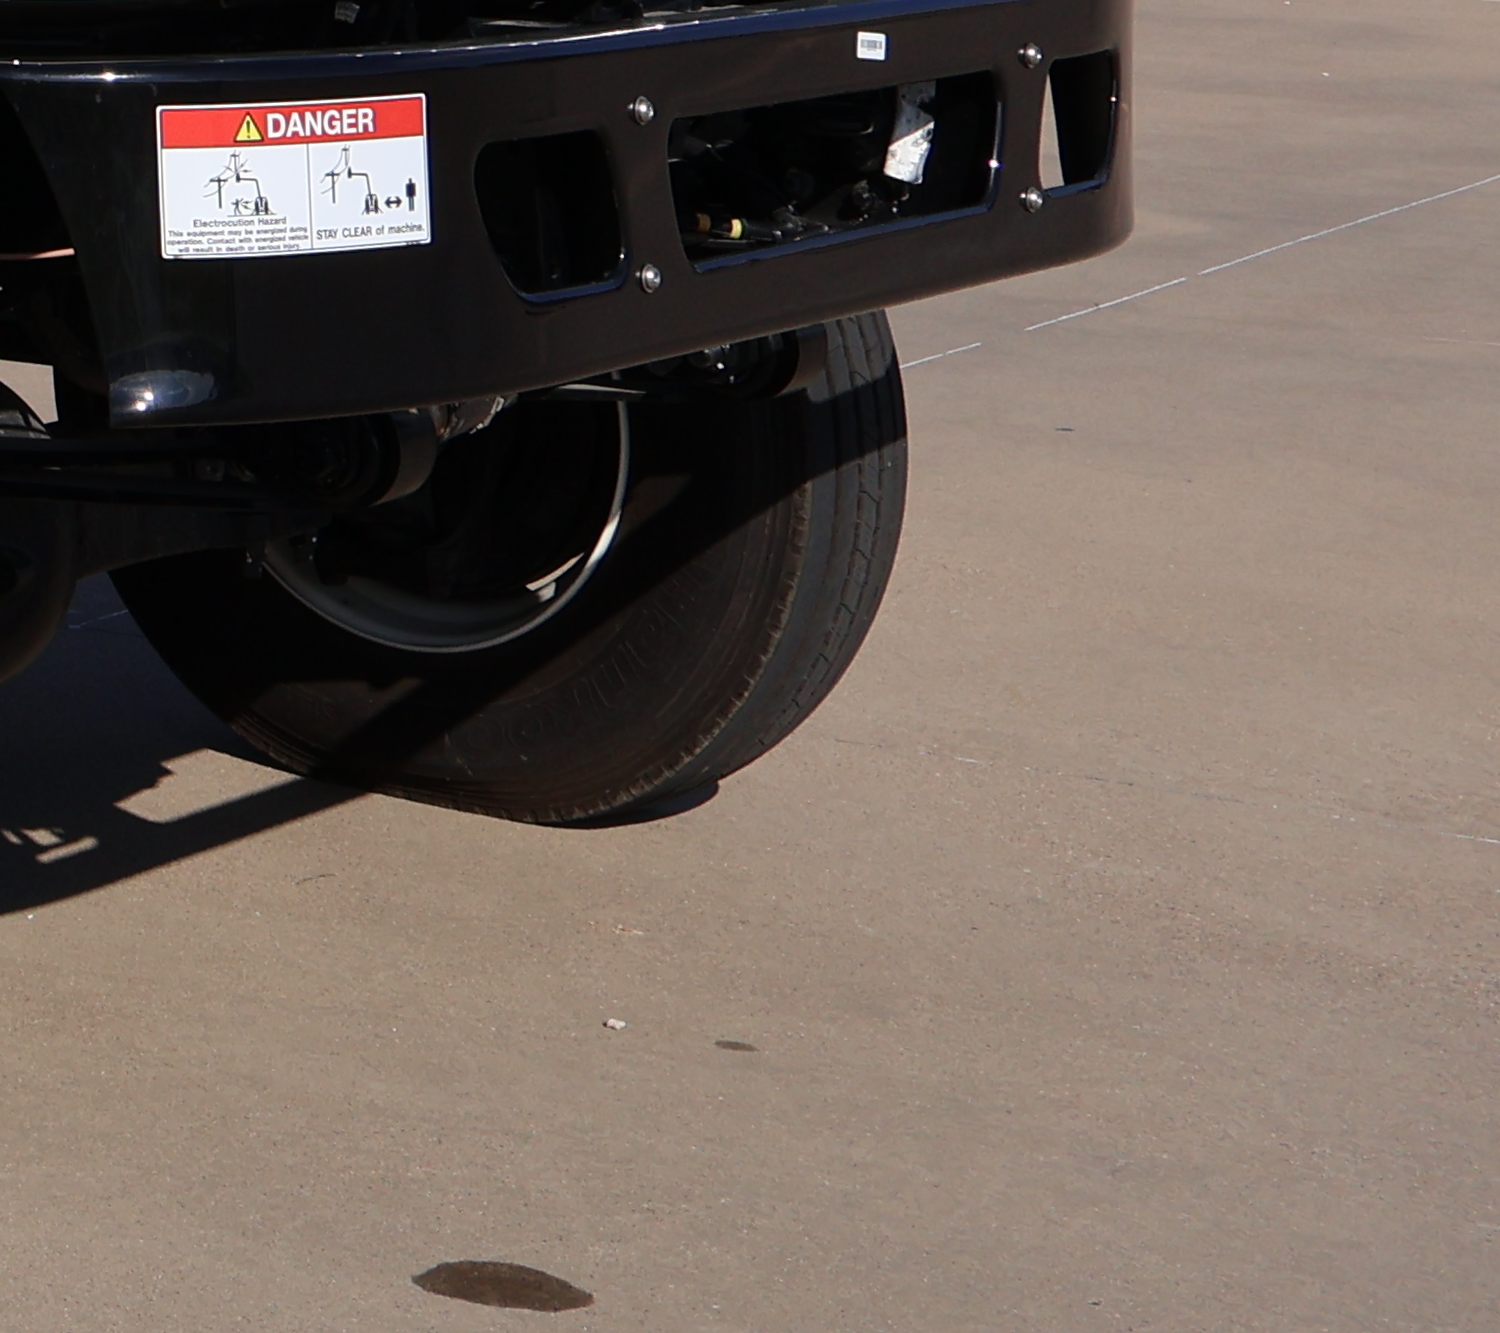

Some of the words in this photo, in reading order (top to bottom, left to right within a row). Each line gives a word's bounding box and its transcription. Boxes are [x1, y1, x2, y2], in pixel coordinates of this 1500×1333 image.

[267, 108, 374, 139] DANGER
[193, 219, 255, 228] Electrocution
[258, 216, 286, 225] Hazard
[316, 228, 338, 240] STAY
[342, 226, 372, 238] CLEAR
[376, 225, 384, 235] of
[388, 222, 425, 234] machine.
